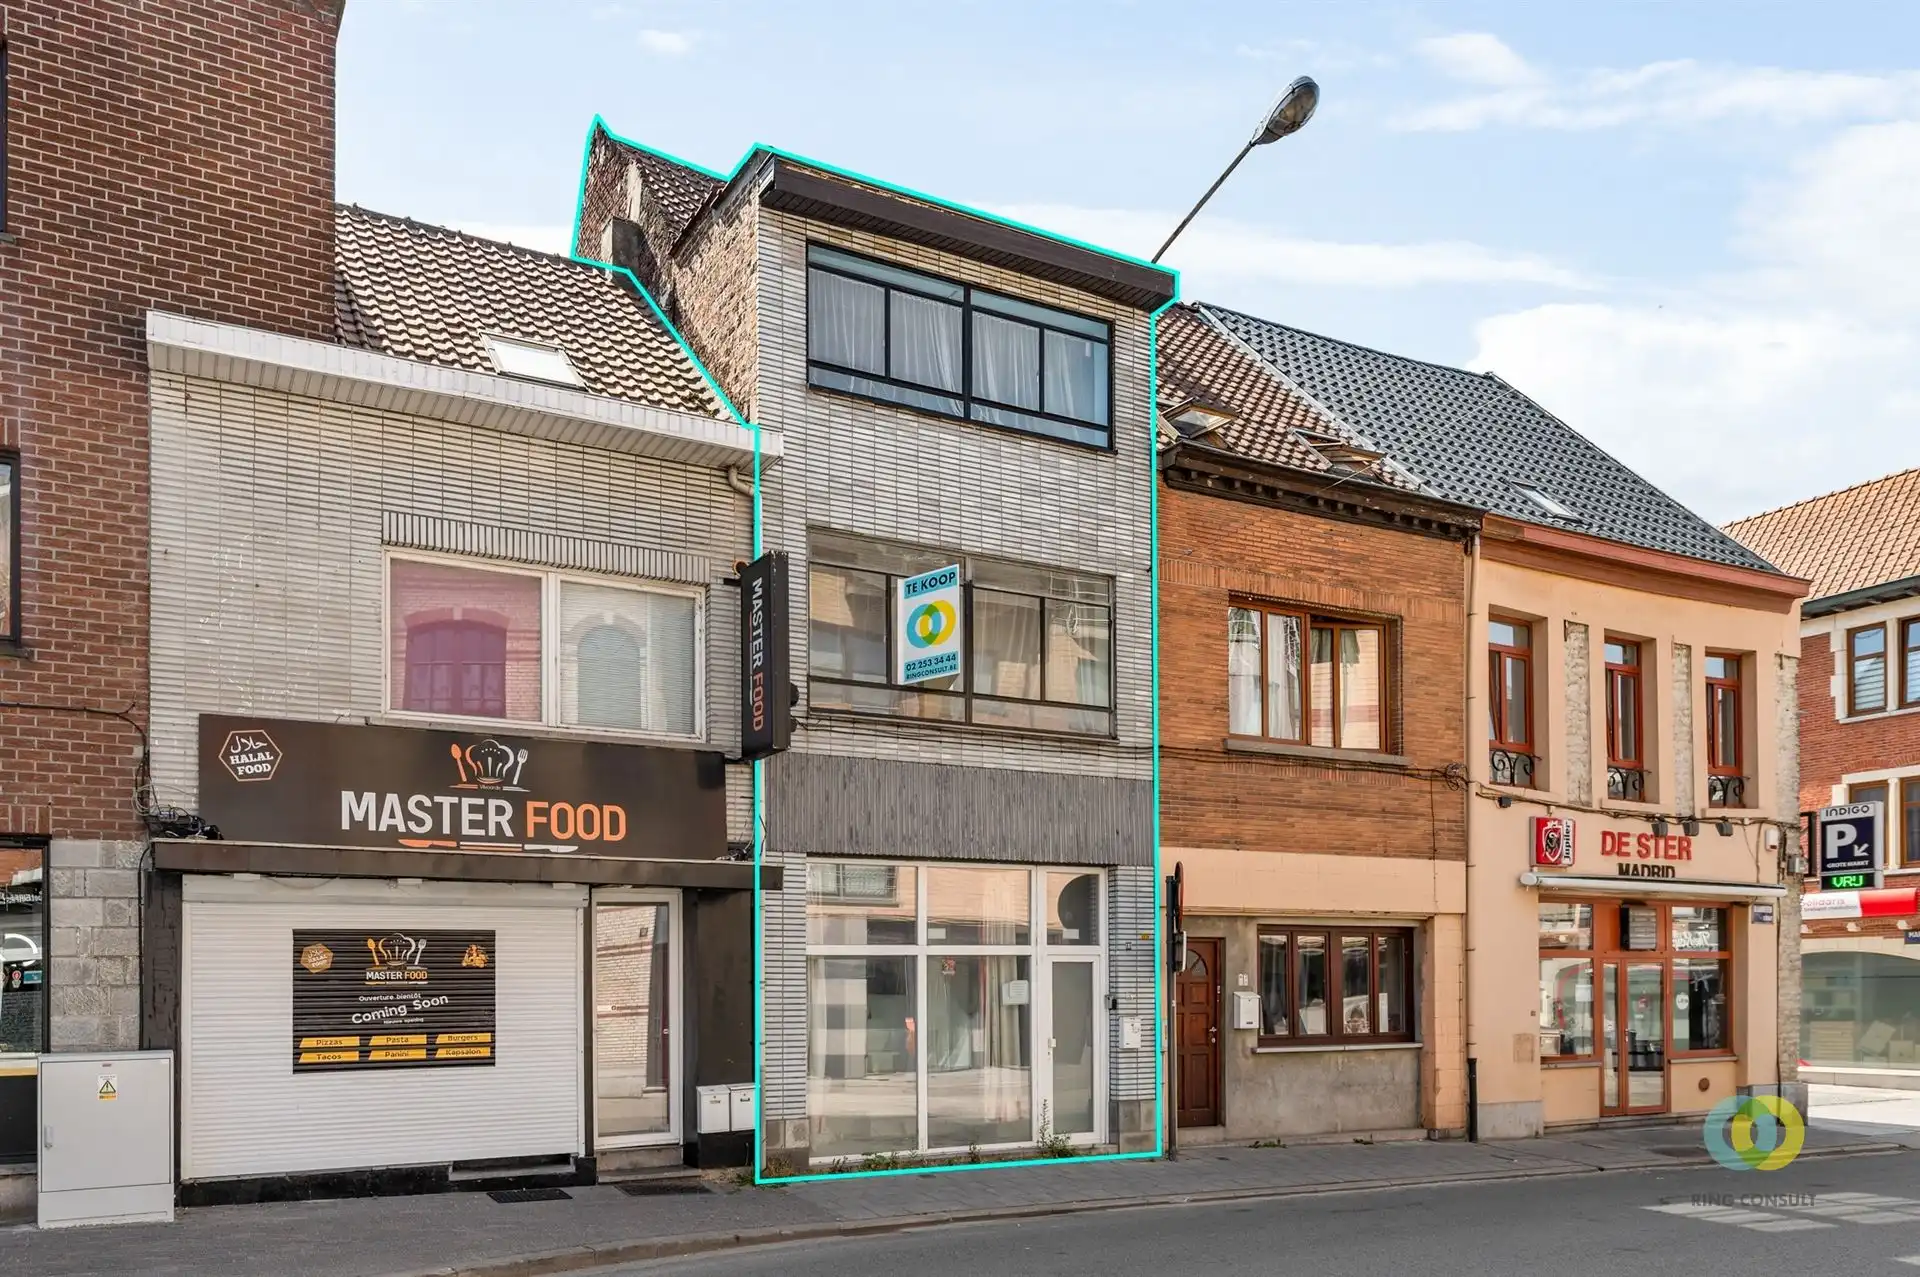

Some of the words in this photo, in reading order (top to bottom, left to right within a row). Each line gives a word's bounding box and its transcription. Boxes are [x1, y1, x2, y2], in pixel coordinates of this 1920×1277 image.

[906, 582, 918, 595] TE
[921, 571, 956, 590] KOOP
[752, 576, 764, 670] MASTER
[906, 663, 916, 671] 02
[918, 659, 932, 669] 253
[934, 656, 944, 665] 34
[946, 653, 956, 662] 44
[906, 664, 957, 680] RINGCONSULT.BE
[752, 671, 764, 732] FOOD
[230, 735, 268, 754] حلال
[229, 751, 274, 765] HALAL
[237, 763, 272, 775] FOOD
[341, 790, 514, 838] MASTER
[526, 801, 627, 842] FOOD
[1825, 805, 1870, 817] INDIGO
[1563, 819, 1572, 860] Jupiler
[1601, 830, 1631, 857] DE
[1637, 833, 1692, 861] STER
[1825, 823, 1858, 859] P
[366, 971, 403, 980] MASTER
[404, 971, 428, 980] FOOD
[352, 1004, 408, 1024] Coming
[412, 995, 449, 1010] Soon
[316, 1038, 343, 1046] Pizzas
[447, 1034, 478, 1042] Burgers
[446, 1048, 482, 1056] Kapsalon
